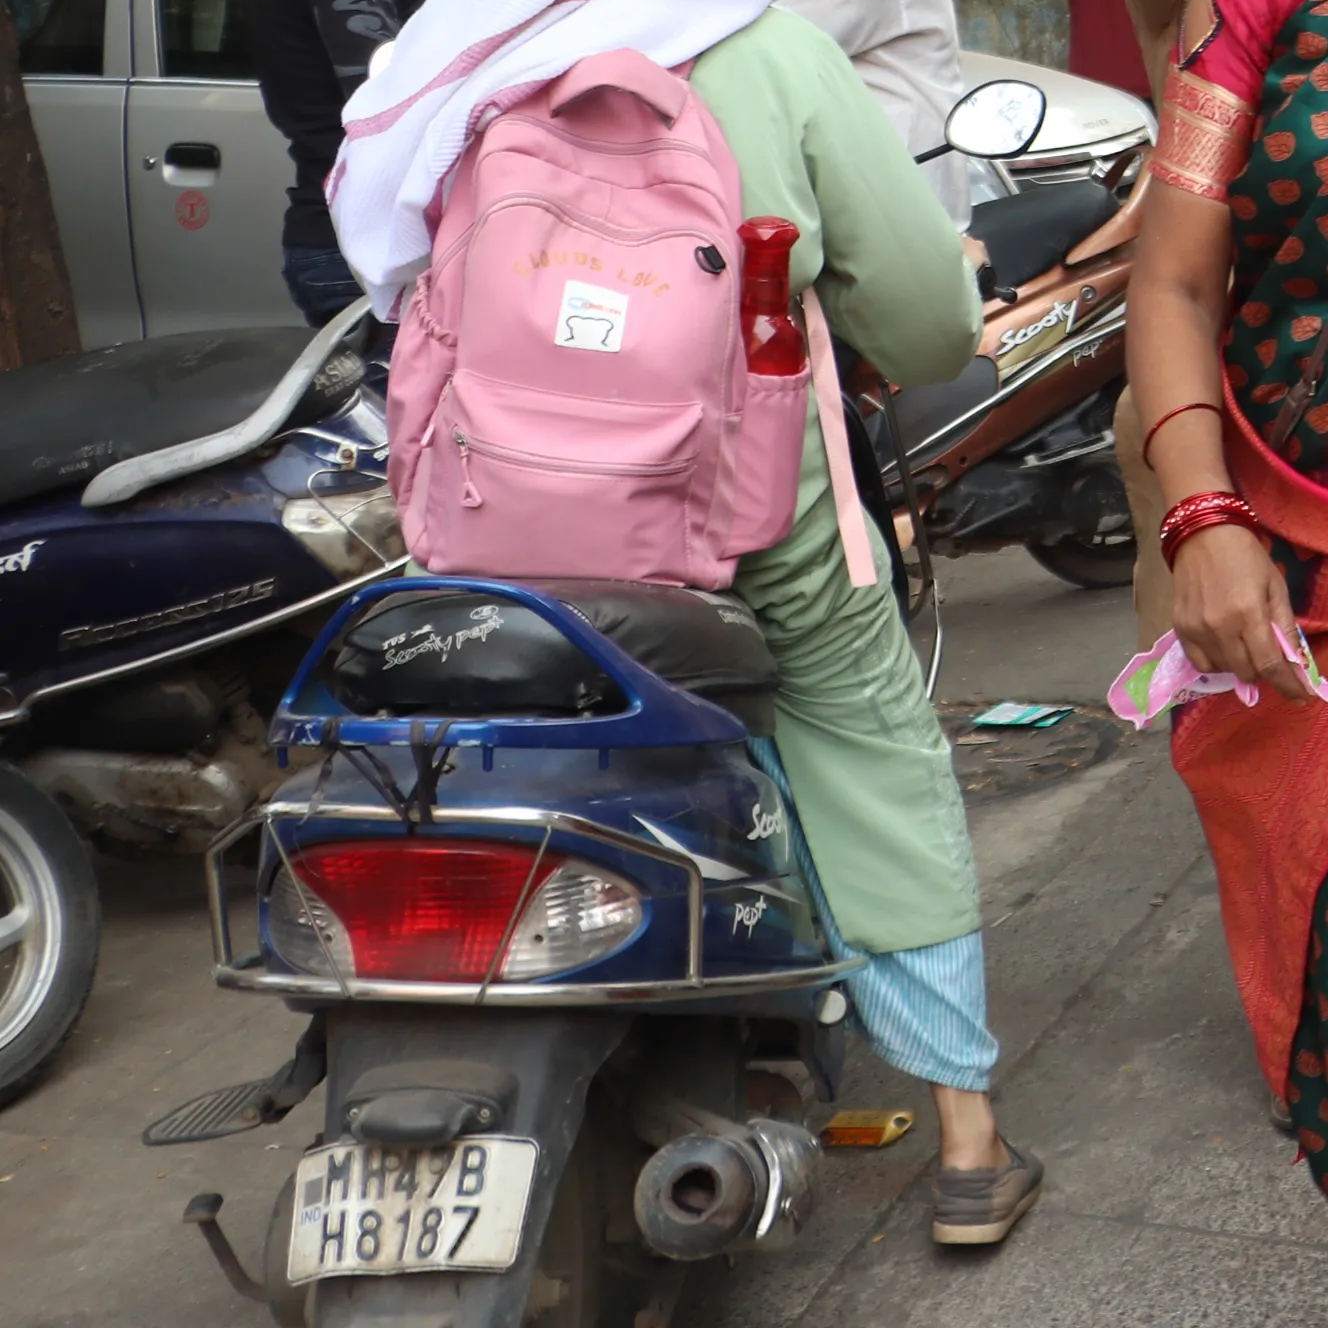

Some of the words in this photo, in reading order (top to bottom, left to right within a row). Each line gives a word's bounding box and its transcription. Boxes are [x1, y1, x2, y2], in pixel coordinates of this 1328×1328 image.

[996, 299, 1078, 356] Scooty
[382, 633, 452, 670] Scooty
[320, 1205, 480, 1265] H8187
